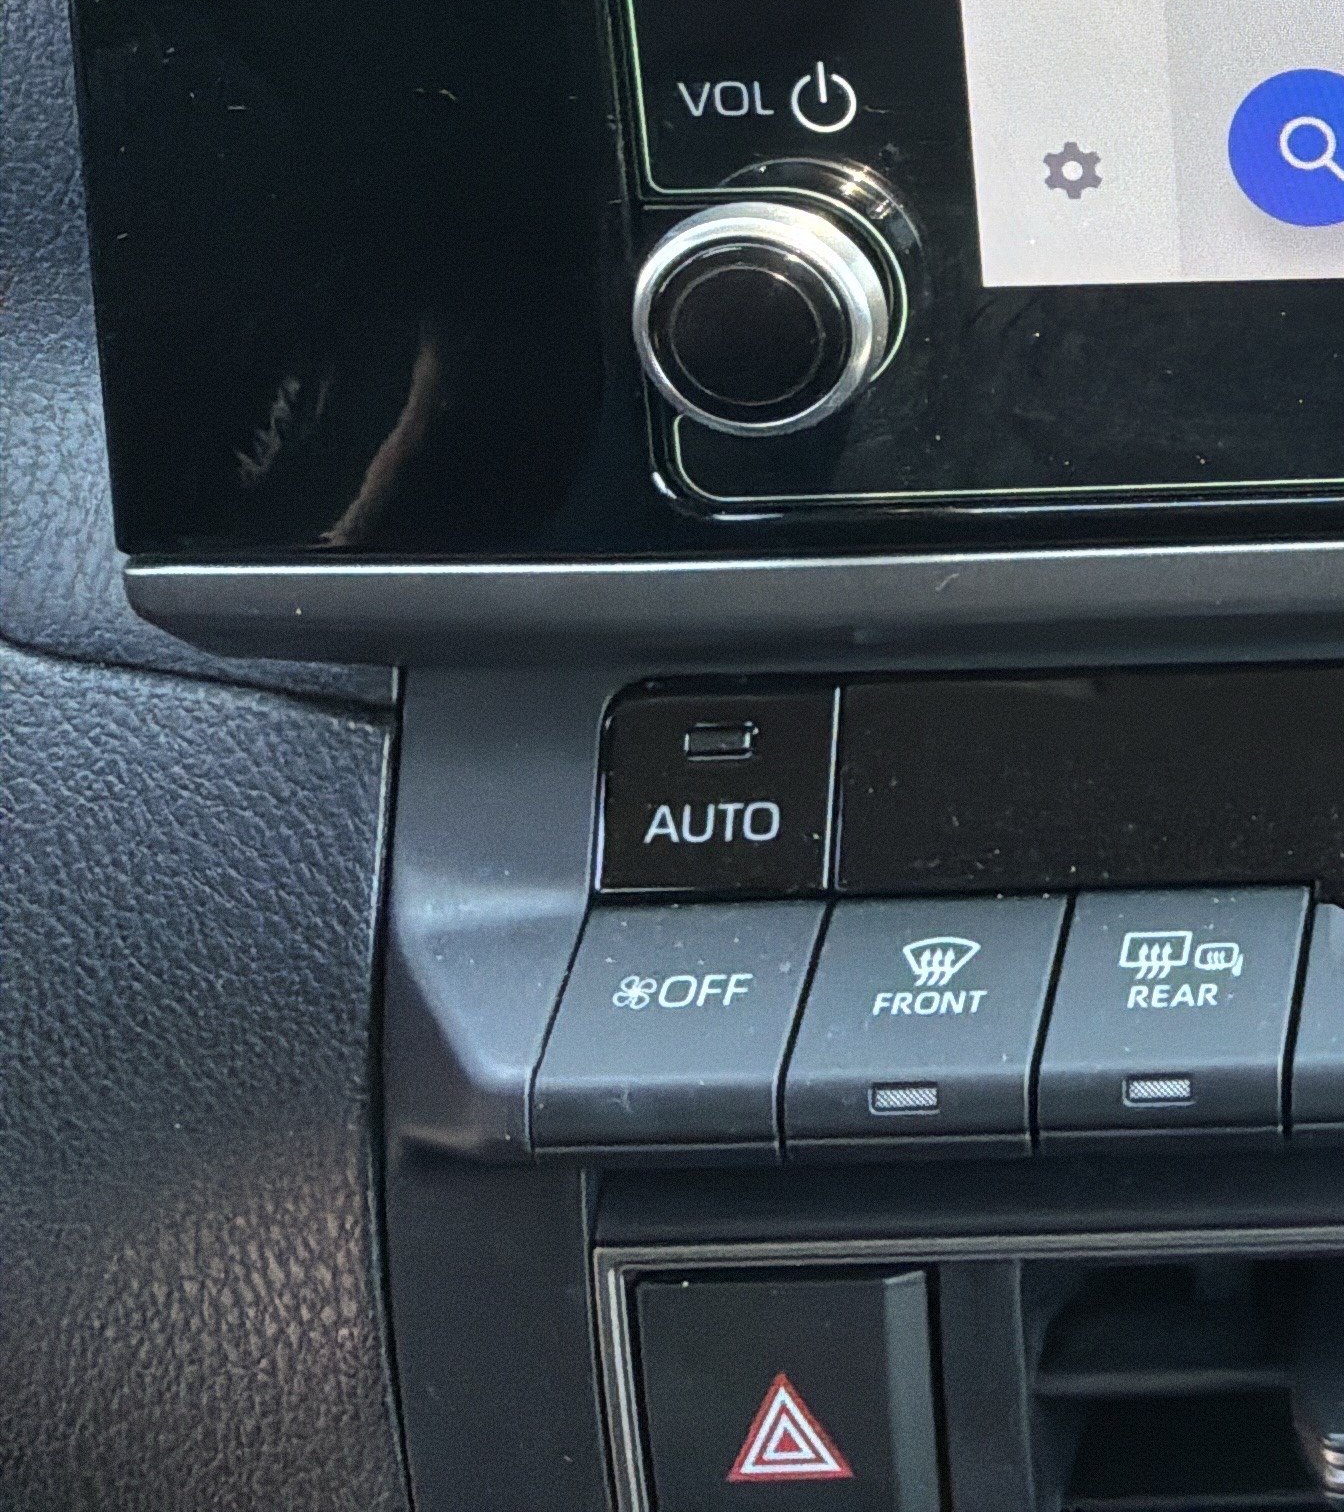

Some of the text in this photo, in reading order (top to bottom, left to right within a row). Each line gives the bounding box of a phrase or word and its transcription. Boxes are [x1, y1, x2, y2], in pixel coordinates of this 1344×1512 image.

[676, 81, 775, 117] VOL
[645, 802, 780, 844] AUTO
[658, 973, 752, 1009] OFF
[872, 989, 986, 1016] FRONT
[1125, 983, 1219, 1009] REAR
